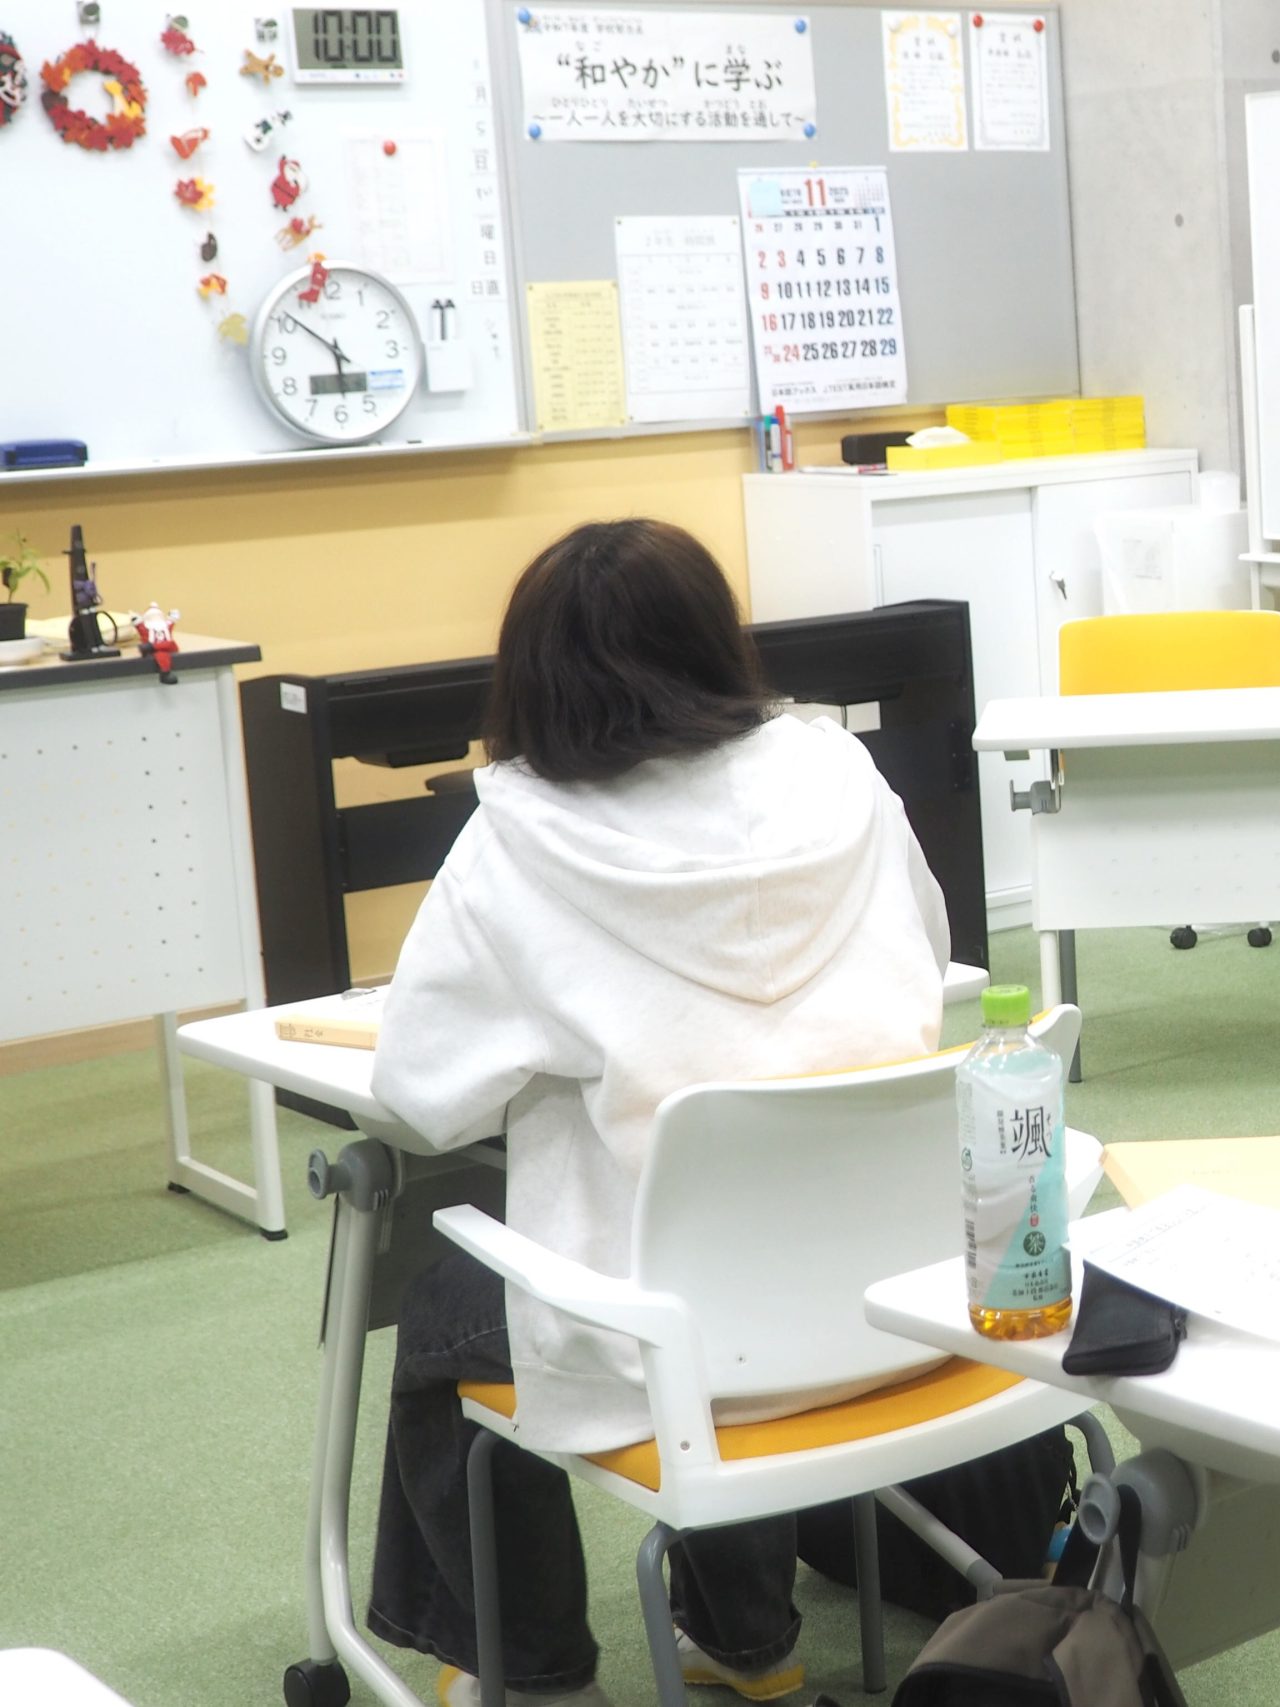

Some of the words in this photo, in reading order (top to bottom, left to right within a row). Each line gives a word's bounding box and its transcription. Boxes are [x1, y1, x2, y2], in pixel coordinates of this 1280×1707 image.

[313, 9, 398, 62] 10:00
[804, 178, 826, 207] 11
[758, 250, 766, 268] 2
[777, 250, 786, 268] 3
[796, 249, 805, 267] 4
[816, 248, 826, 266] 5
[836, 248, 845, 265] 6
[856, 247, 864, 264] 7
[876, 246, 884, 264] 8
[324, 280, 341, 300] 2
[760, 282, 770, 300] 9
[777, 281, 793, 300] 10
[796, 281, 812, 299] 11
[816, 279, 832, 298] 12
[836, 279, 851, 296] 13
[855, 278, 870, 295] 14
[875, 276, 890, 294] 15
[375, 310, 390, 329] 2
[762, 313, 778, 331] 16
[781, 312, 796, 330] 17
[800, 312, 816, 330] 18
[819, 311, 835, 329] 19
[838, 309, 855, 328] 20
[858, 309, 873, 326] 21
[877, 307, 893, 326] 22
[271, 346, 287, 366] 9
[385, 340, 399, 359] 3
[783, 344, 800, 362] 24
[802, 343, 819, 361] 25
[822, 342, 838, 360] 26
[841, 341, 857, 359] 27
[861, 339, 877, 358] 28
[880, 338, 897, 356] 29
[282, 376, 297, 396] 8
[305, 398, 318, 417] 7
[362, 394, 377, 413] 5
[334, 404, 348, 424] 6
[1010, 1106, 1052, 1161] 颯
